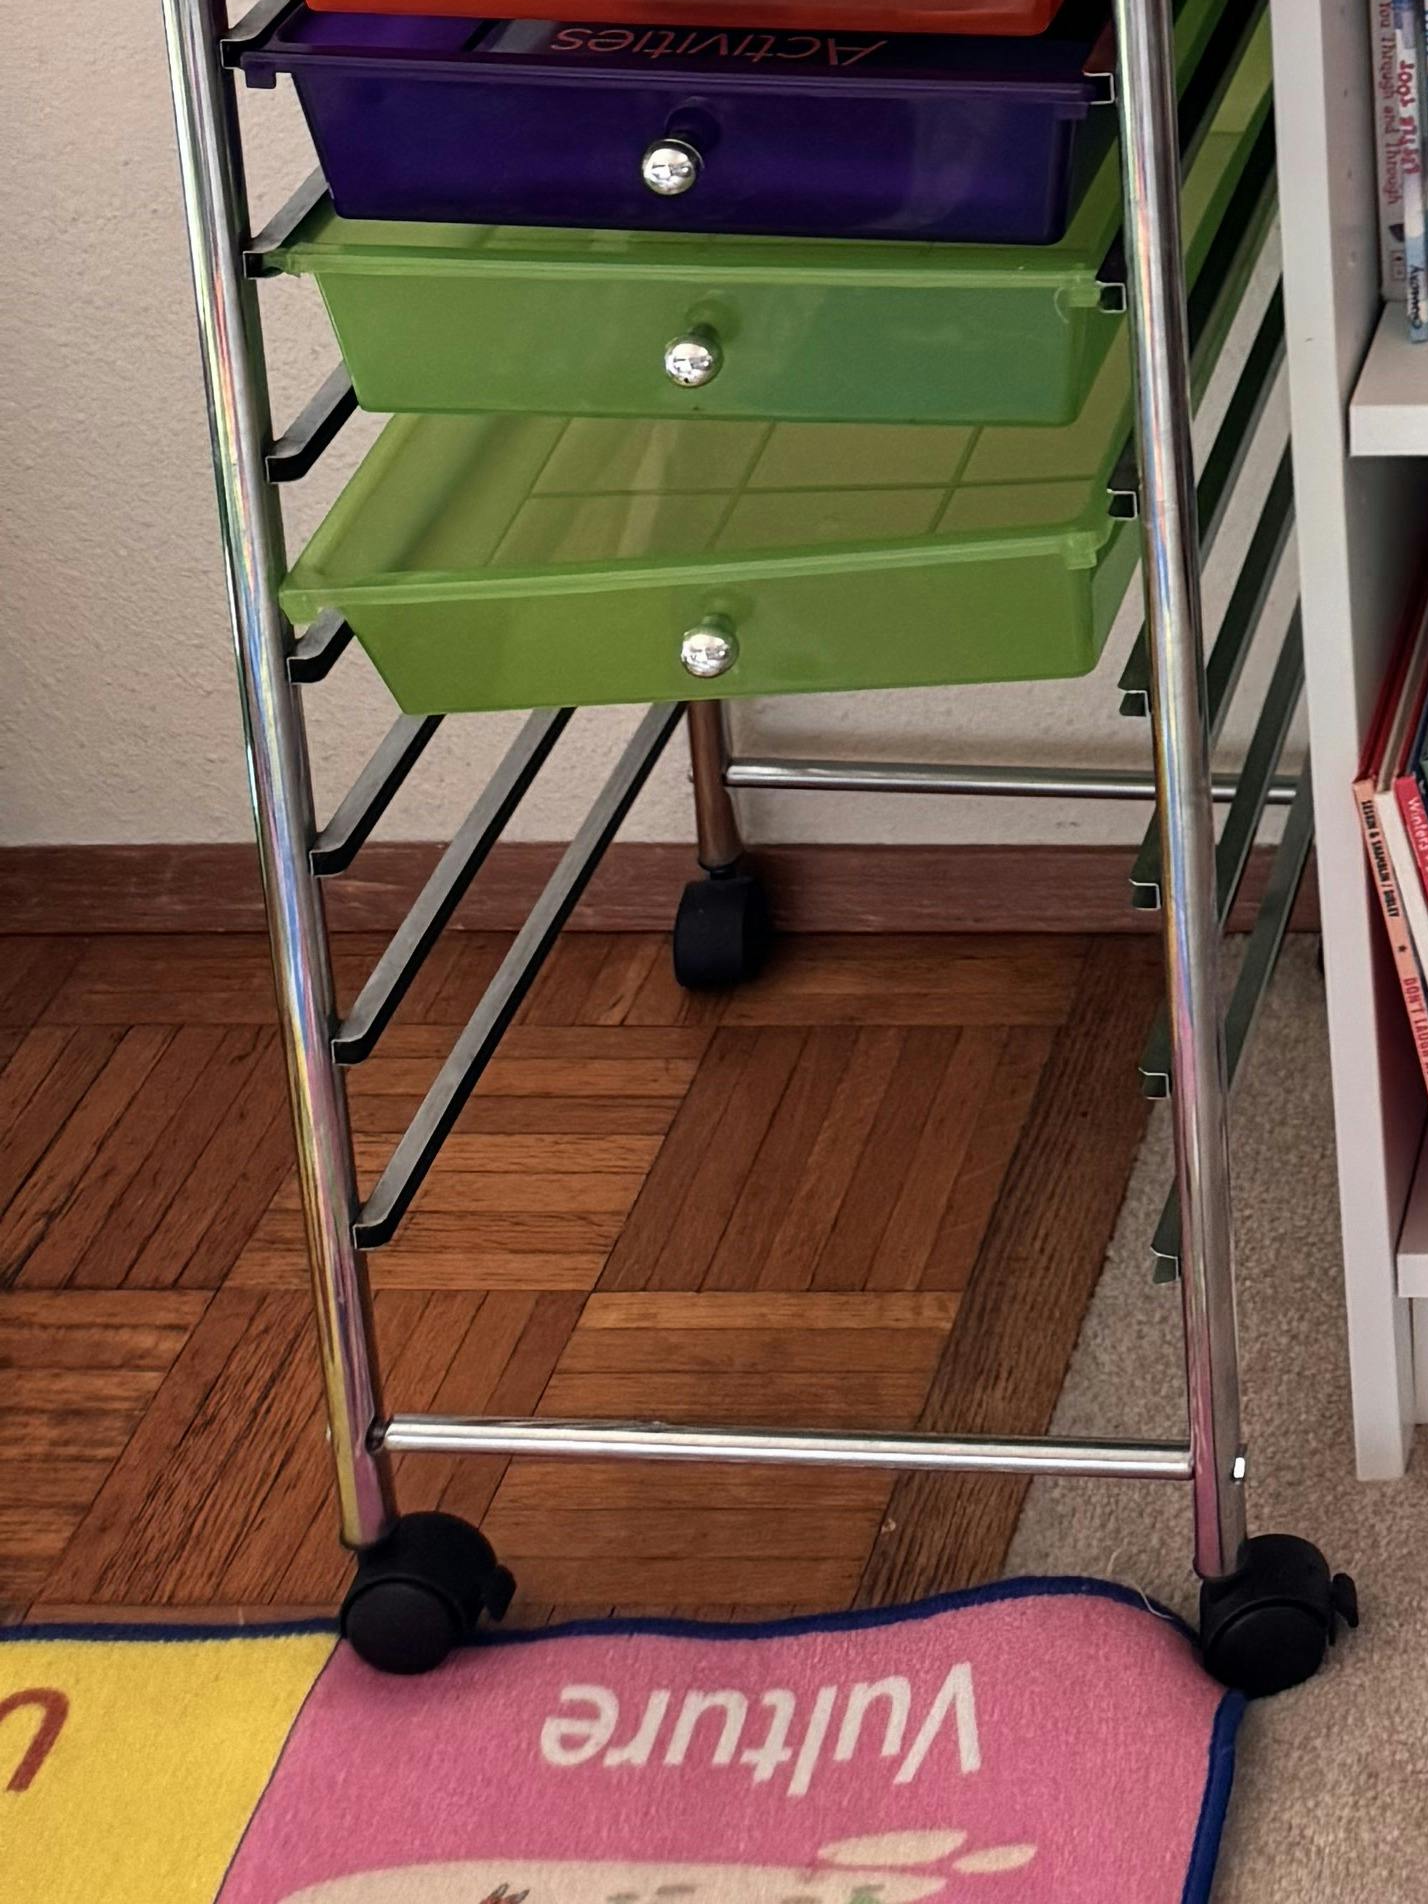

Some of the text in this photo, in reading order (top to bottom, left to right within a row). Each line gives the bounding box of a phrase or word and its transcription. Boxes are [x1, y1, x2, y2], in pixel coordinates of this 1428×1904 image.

[550, 28, 889, 67] Activities
[1380, 0, 1401, 205] You Through Through
[1403, 976, 1422, 1017] DON'T
[538, 1661, 985, 1795] Vulture
